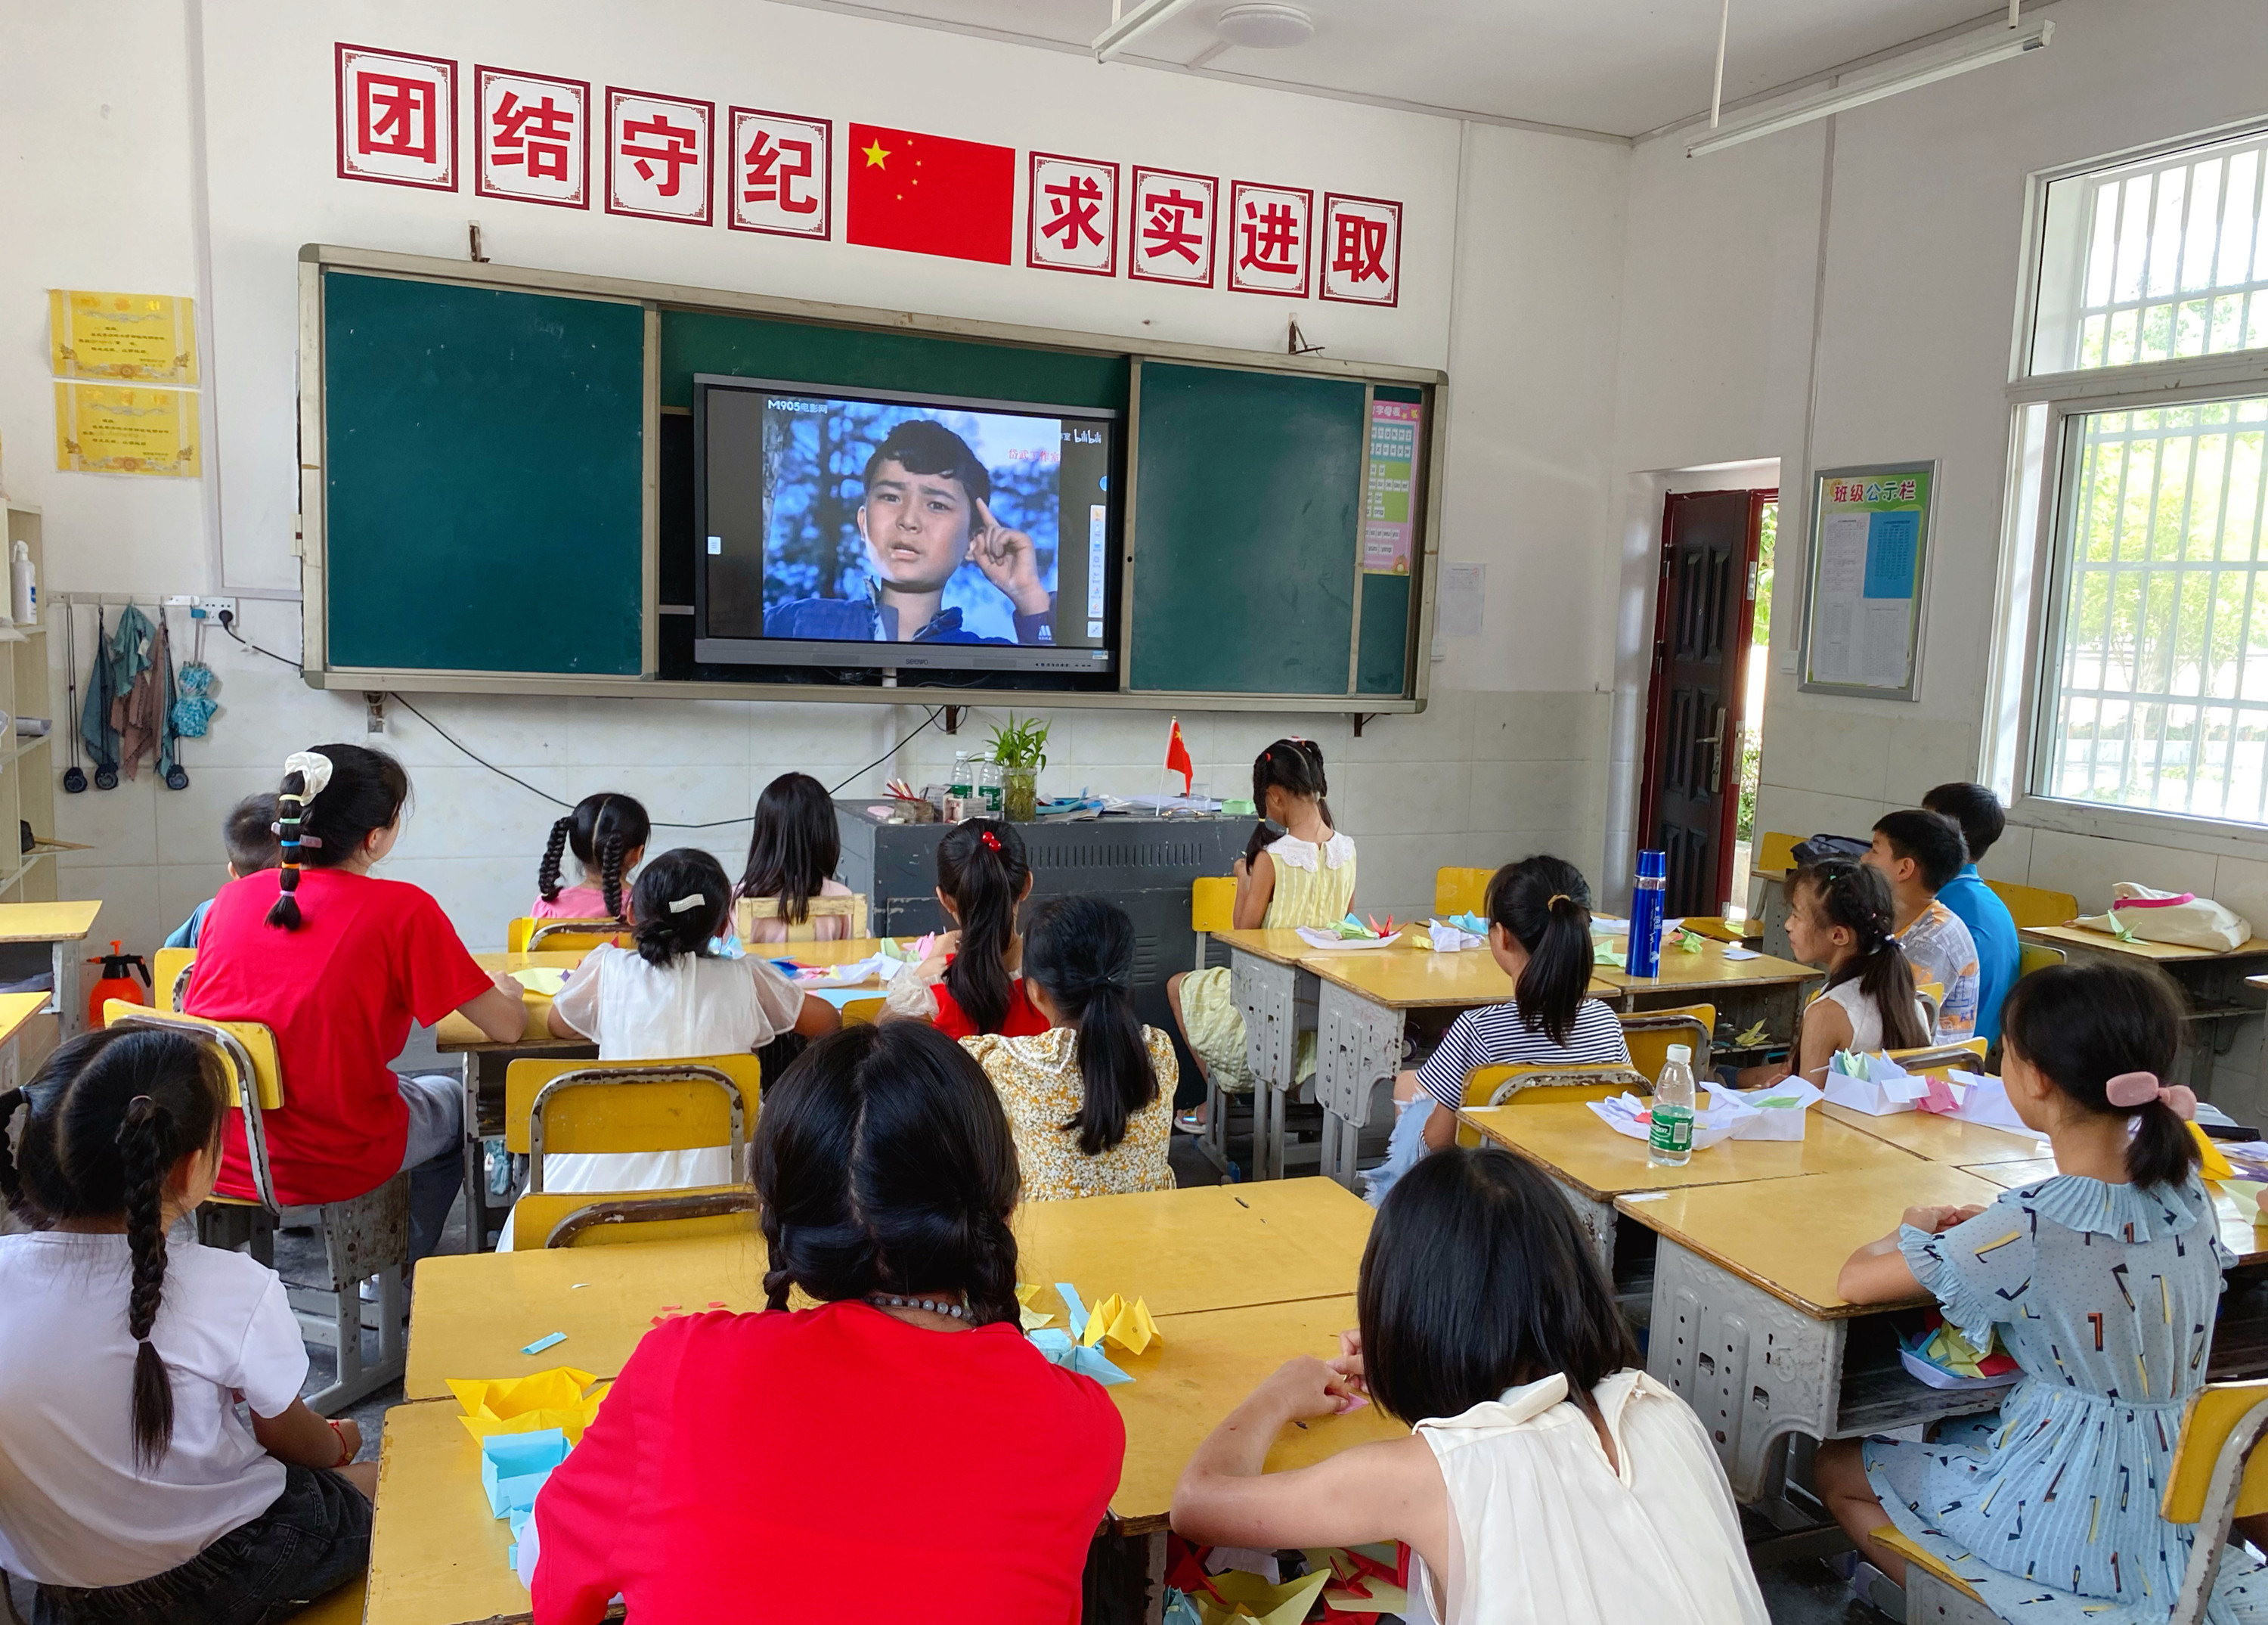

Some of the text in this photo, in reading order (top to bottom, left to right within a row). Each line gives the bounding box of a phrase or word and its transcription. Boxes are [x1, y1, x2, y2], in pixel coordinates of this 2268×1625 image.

[357, 71, 1390, 284] 团结守纪 求实进取
[1372, 405, 1401, 417] 字母表
[1074, 428, 1102, 444] bilibili
[1833, 479, 1916, 503] 班级公示栏
